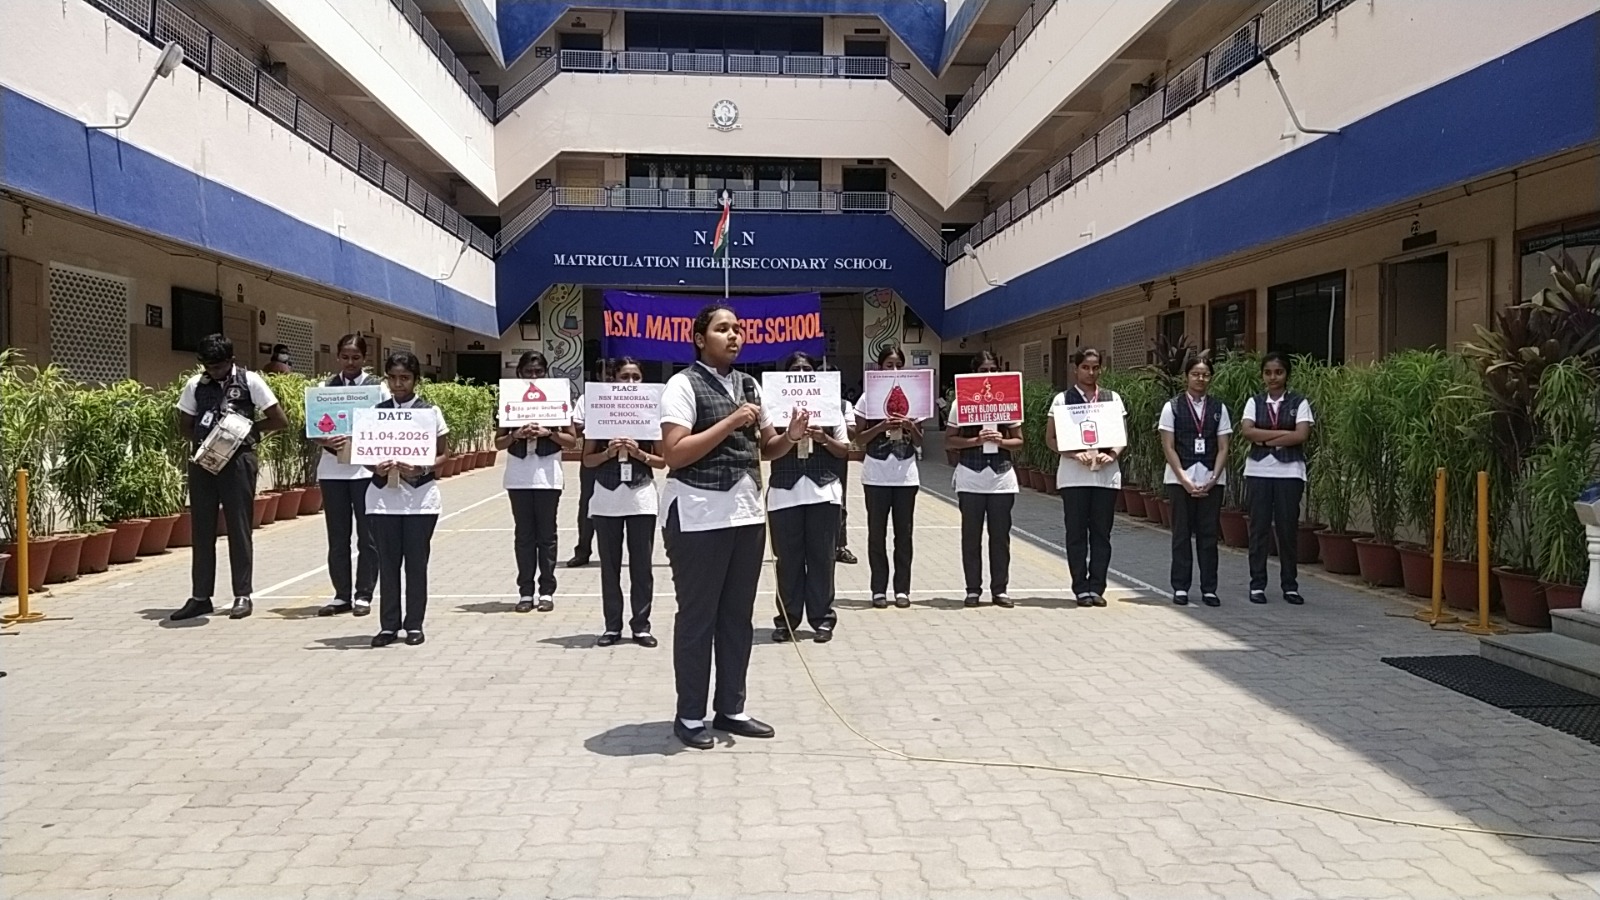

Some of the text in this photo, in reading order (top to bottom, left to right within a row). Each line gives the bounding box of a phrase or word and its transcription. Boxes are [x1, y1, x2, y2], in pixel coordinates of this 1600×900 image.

[693, 231, 756, 246] N..N
[553, 254, 680, 268] MATRICULATION
[833, 257, 893, 270] SCHOOL
[603, 310, 642, 338] N.S.N.
[764, 312, 825, 344] SCHOOL
[786, 375, 816, 383] TIME
[781, 388, 821, 396] 9.00 AM
[960, 402, 1018, 414] EVERY BLOOD DONOR
[378, 412, 412, 420] DATE
[968, 411, 1011, 422] IS A LIFE SAVER
[359, 431, 430, 441] 11.04.2026
[357, 446, 429, 456] SATURDAY
